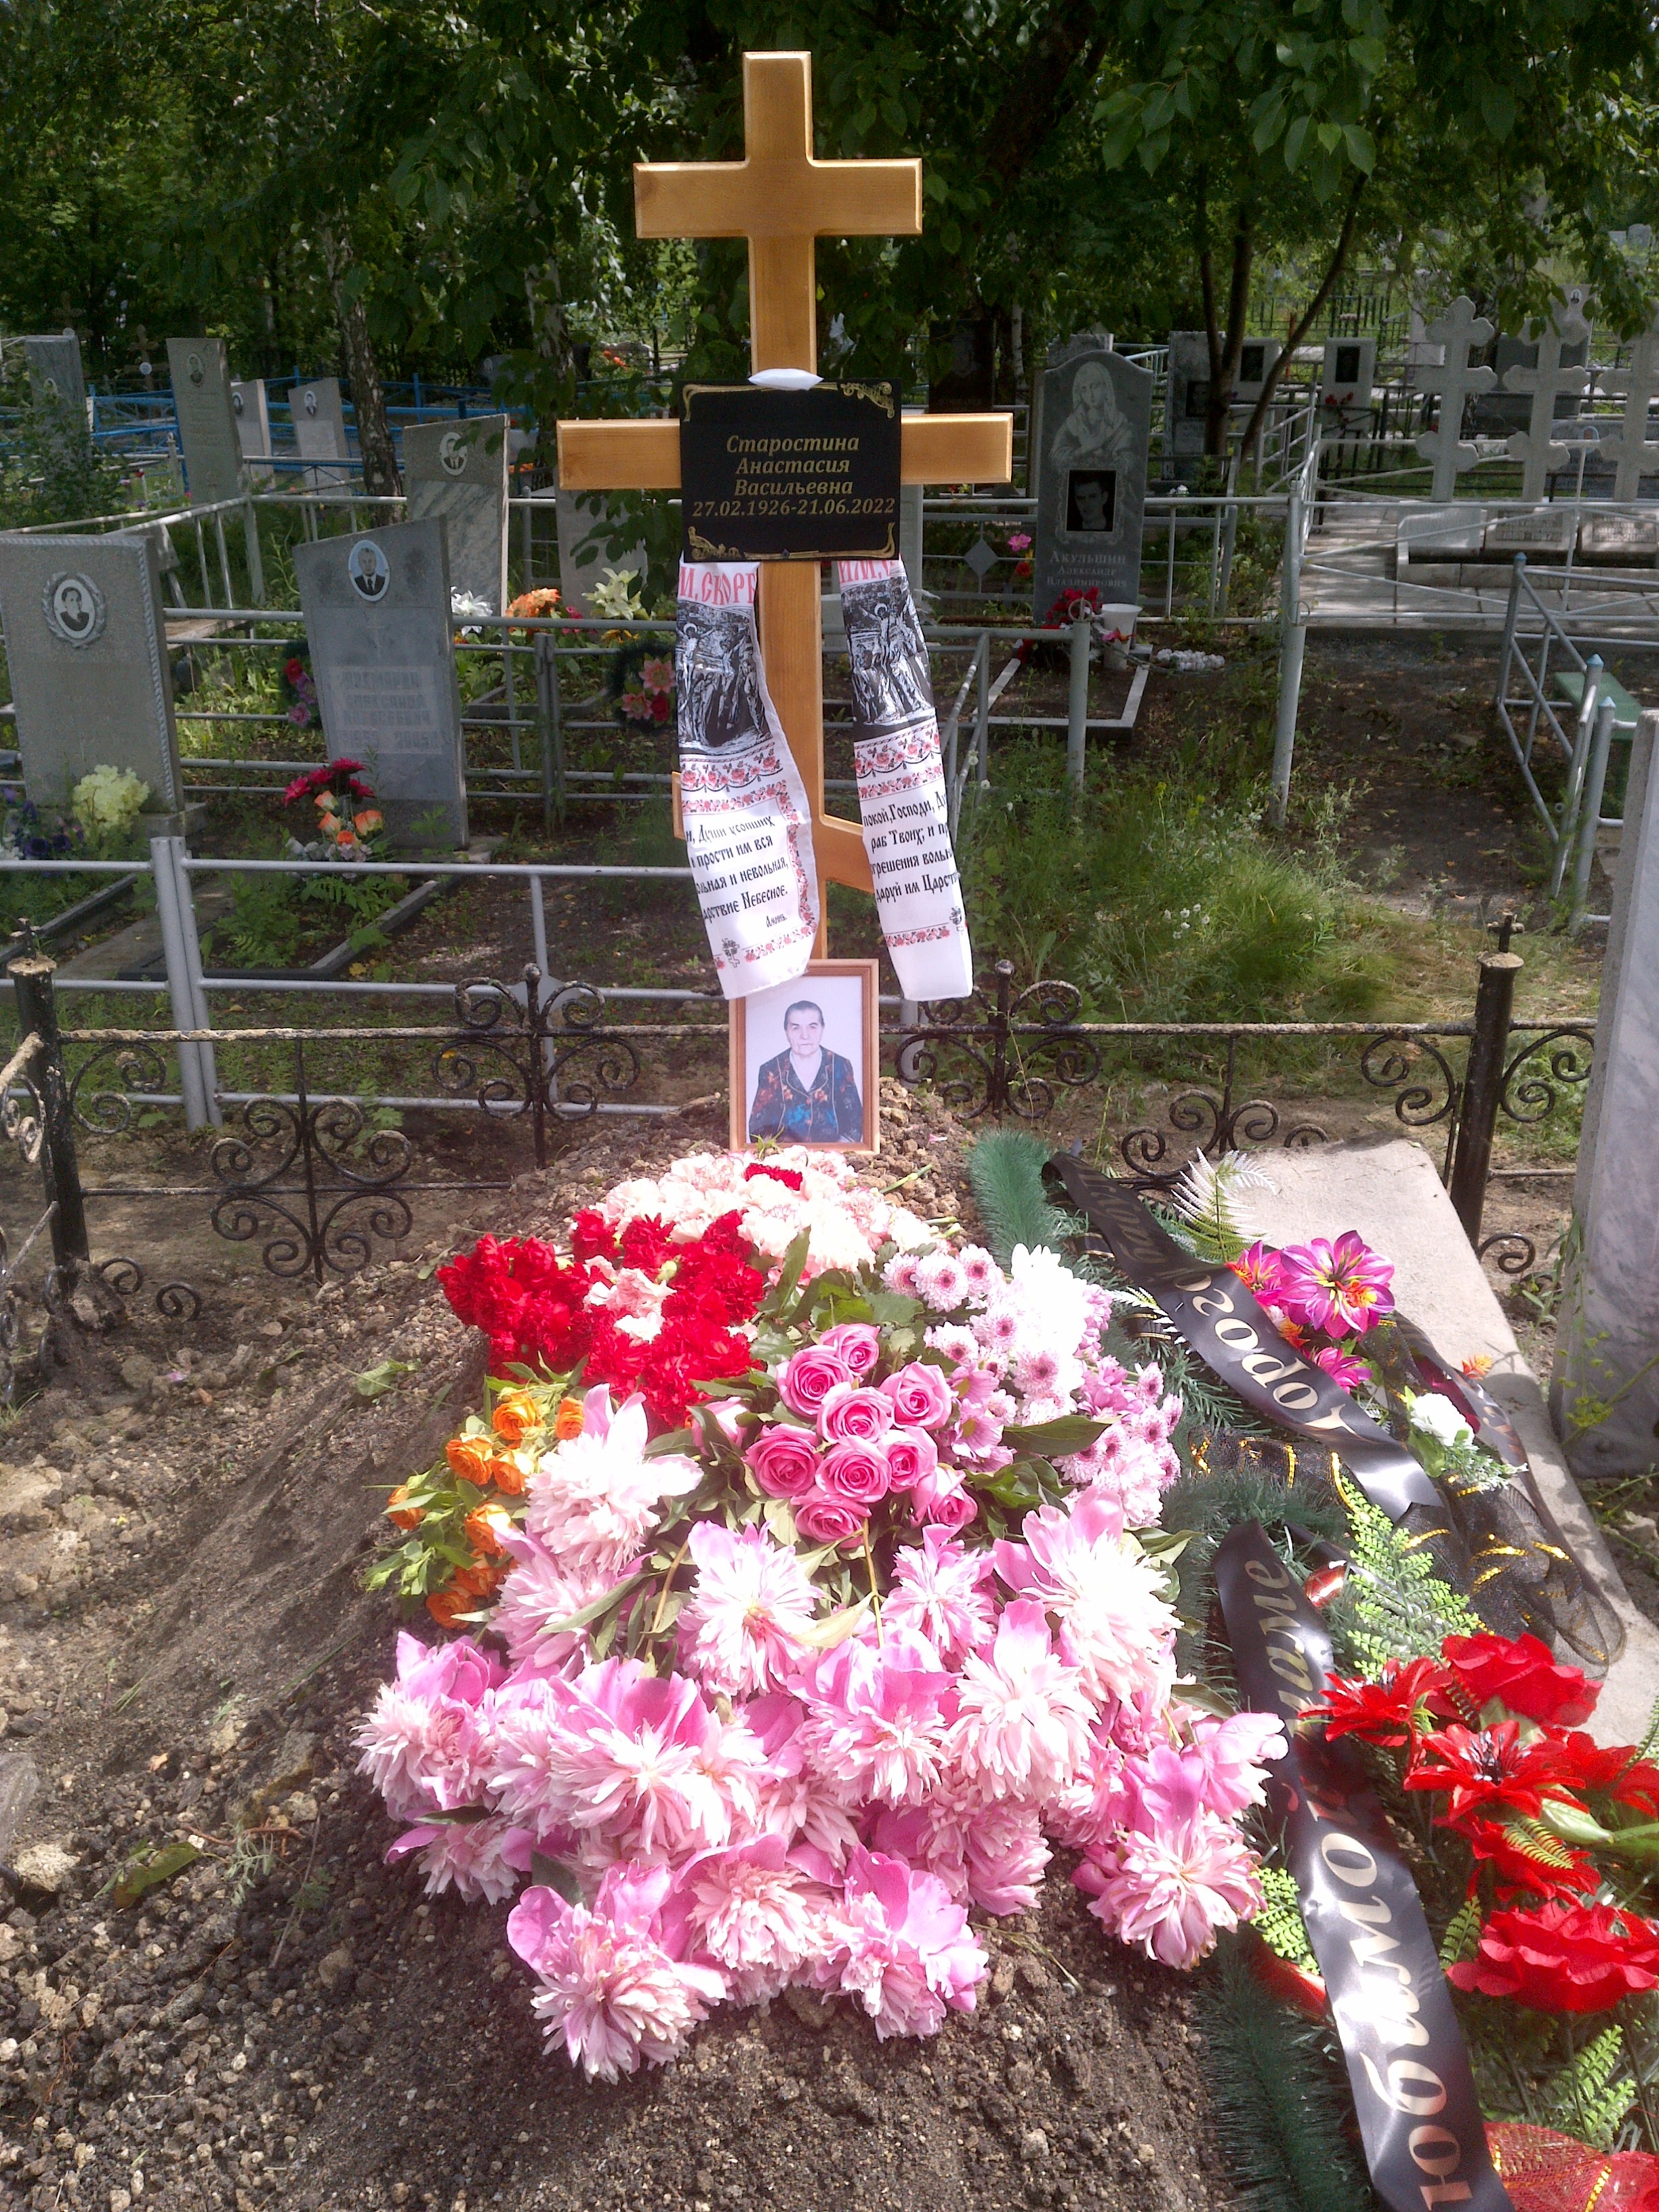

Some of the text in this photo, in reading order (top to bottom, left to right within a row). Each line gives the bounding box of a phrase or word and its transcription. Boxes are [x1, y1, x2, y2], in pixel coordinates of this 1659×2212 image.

[726, 435, 859, 455] Старостина
[736, 458, 850, 475] Анастасия
[734, 479, 853, 496] Васильевна
[692, 497, 895, 517] 27.02.1926-21.06.2022
[863, 808, 893, 827] покой,
[888, 800, 935, 820] Господи,
[871, 836, 887, 854] раб
[888, 828, 924, 846] Твоих;
[927, 825, 935, 837] и
[697, 847, 734, 871] прости
[735, 842, 753, 856] им
[754, 835, 774, 850] вся
[729, 873, 737, 886] и
[739, 857, 789, 882] невольная,
[876, 882, 902, 903] даруй
[905, 882, 920, 895] им
